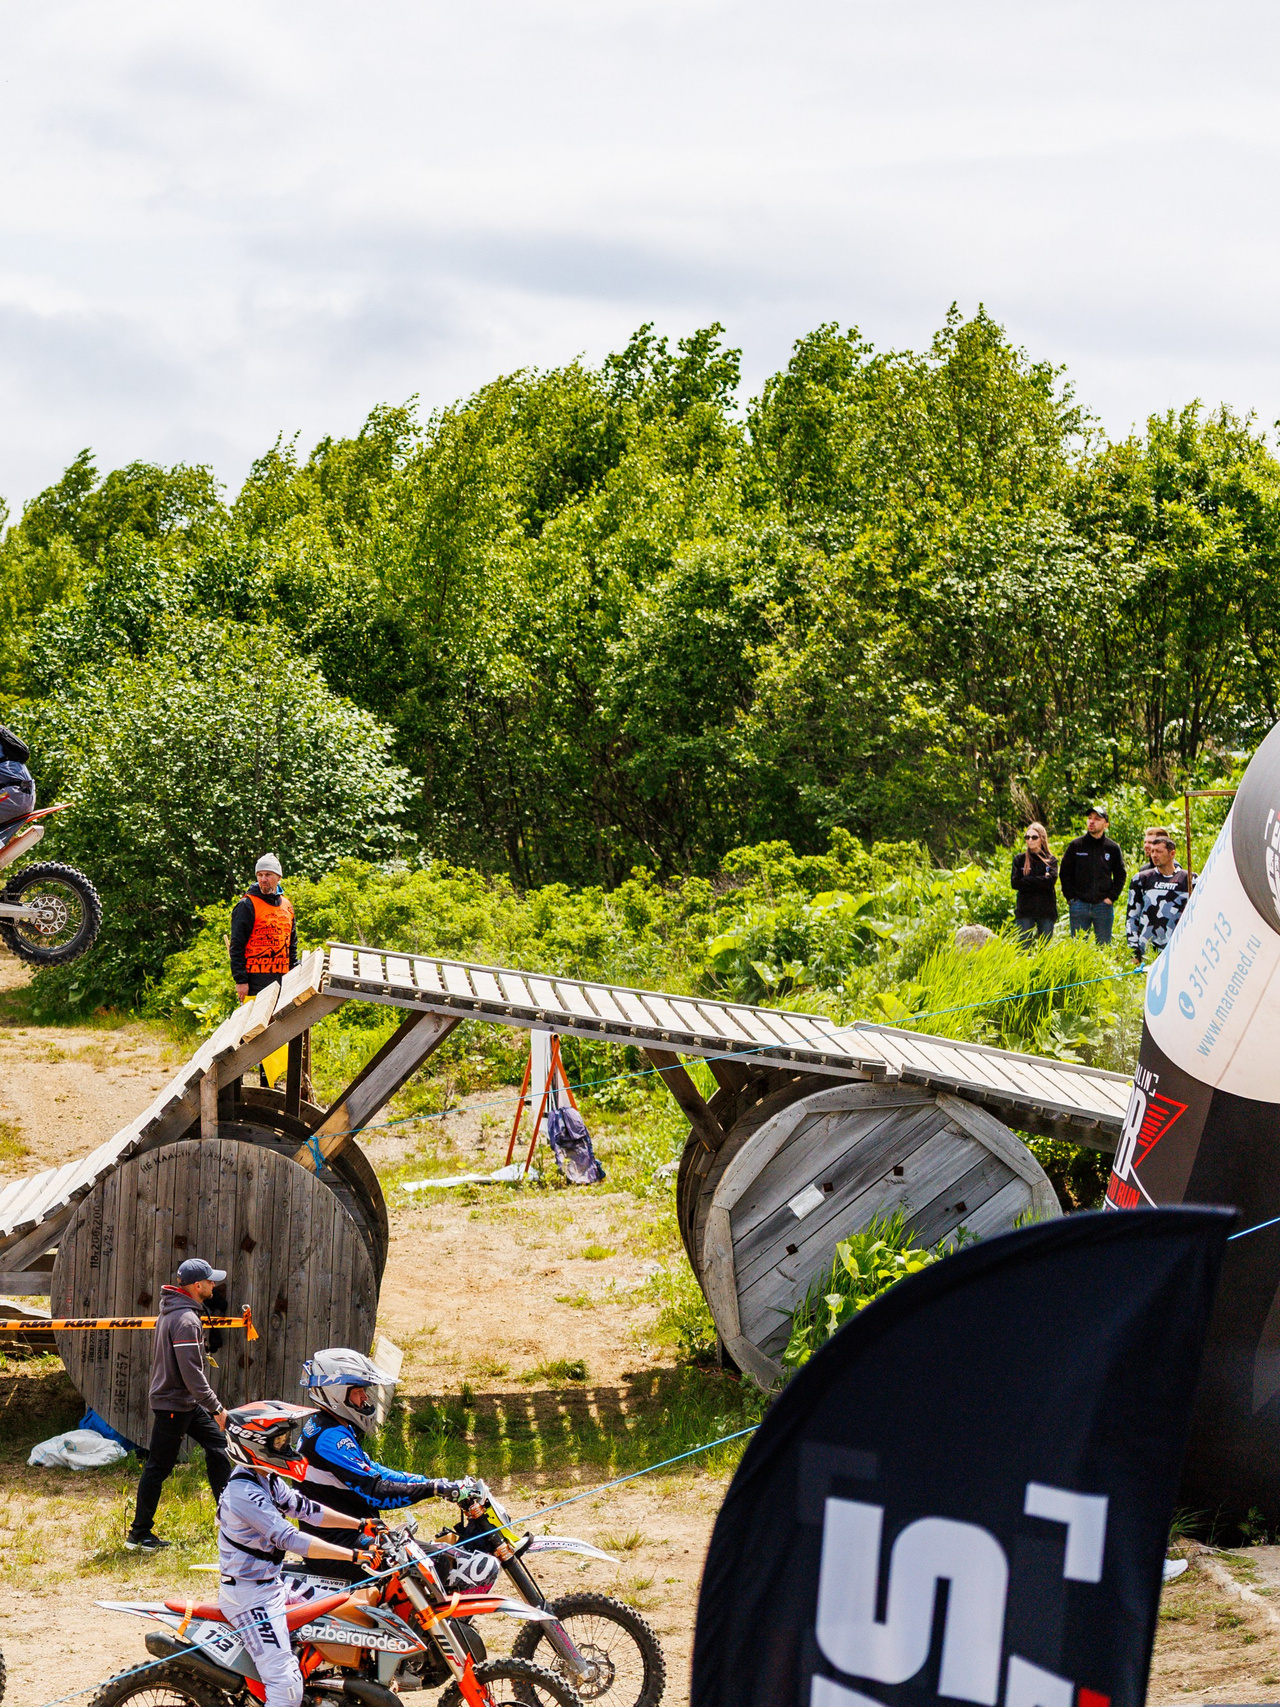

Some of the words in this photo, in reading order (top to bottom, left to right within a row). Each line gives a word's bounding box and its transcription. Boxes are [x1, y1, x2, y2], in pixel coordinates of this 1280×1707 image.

[1154, 882, 1178, 890] LEATT
[1188, 912, 1233, 999] 31-13-13
[1197, 934, 1263, 1057] www.maremed.ru
[140, 1161, 153, 1174] НЕ
[20, 1320, 53, 1328] KTM
[64, 1319, 97, 1328] KTM
[109, 1319, 142, 1328] KTM
[228, 1423, 268, 1445] 100%
[205, 1629, 234, 1653] 113
[300, 1624, 409, 1652] erzbergrodeo
